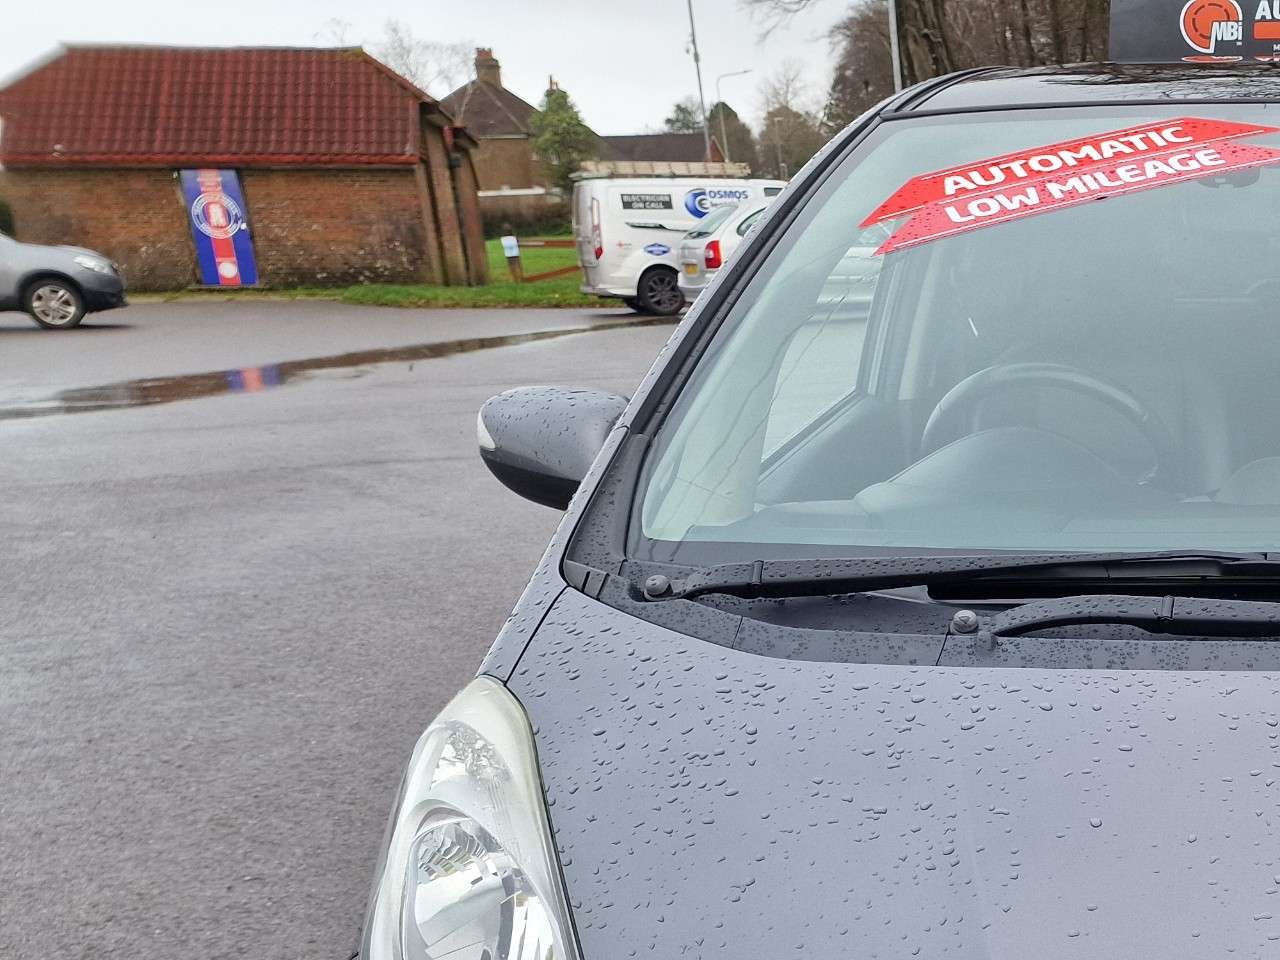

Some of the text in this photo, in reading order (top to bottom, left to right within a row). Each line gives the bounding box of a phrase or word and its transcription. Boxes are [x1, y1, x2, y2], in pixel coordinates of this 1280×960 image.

[943, 126, 1193, 196] AUTOMATIC
[945, 148, 1226, 223] LOW MILEAGE
